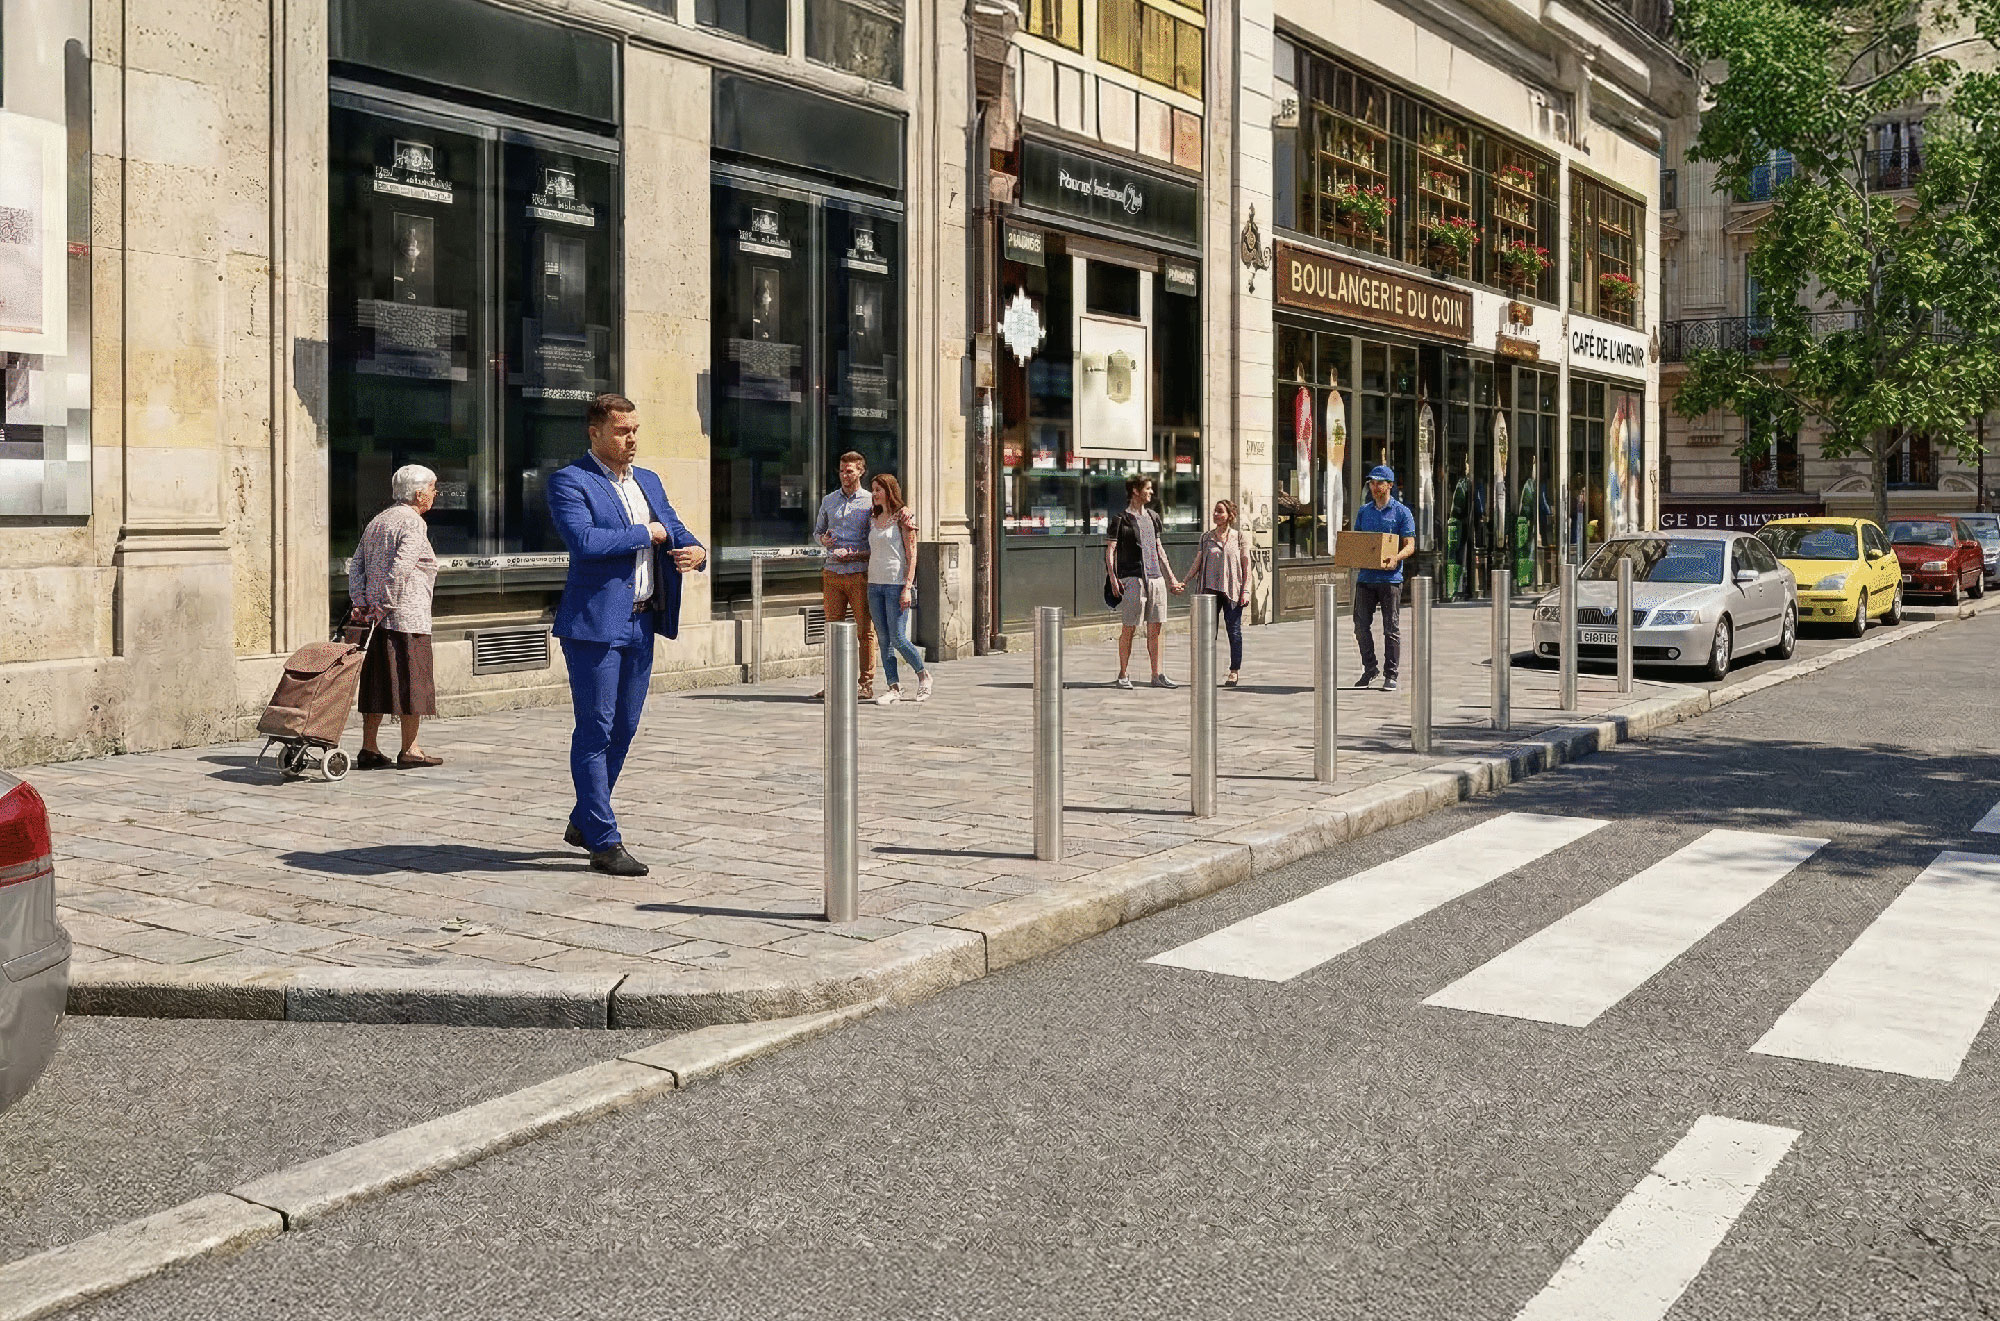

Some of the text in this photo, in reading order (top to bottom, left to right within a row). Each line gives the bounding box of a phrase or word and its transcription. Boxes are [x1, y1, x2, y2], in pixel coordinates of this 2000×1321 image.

[1291, 260, 1463, 329] BOULANGERIE DU COIN
[1572, 328, 1595, 357] CAFÉ
[1596, 336, 1608, 360] DE
[1660, 513, 1688, 527] GE
[1696, 514, 1718, 527] DE
